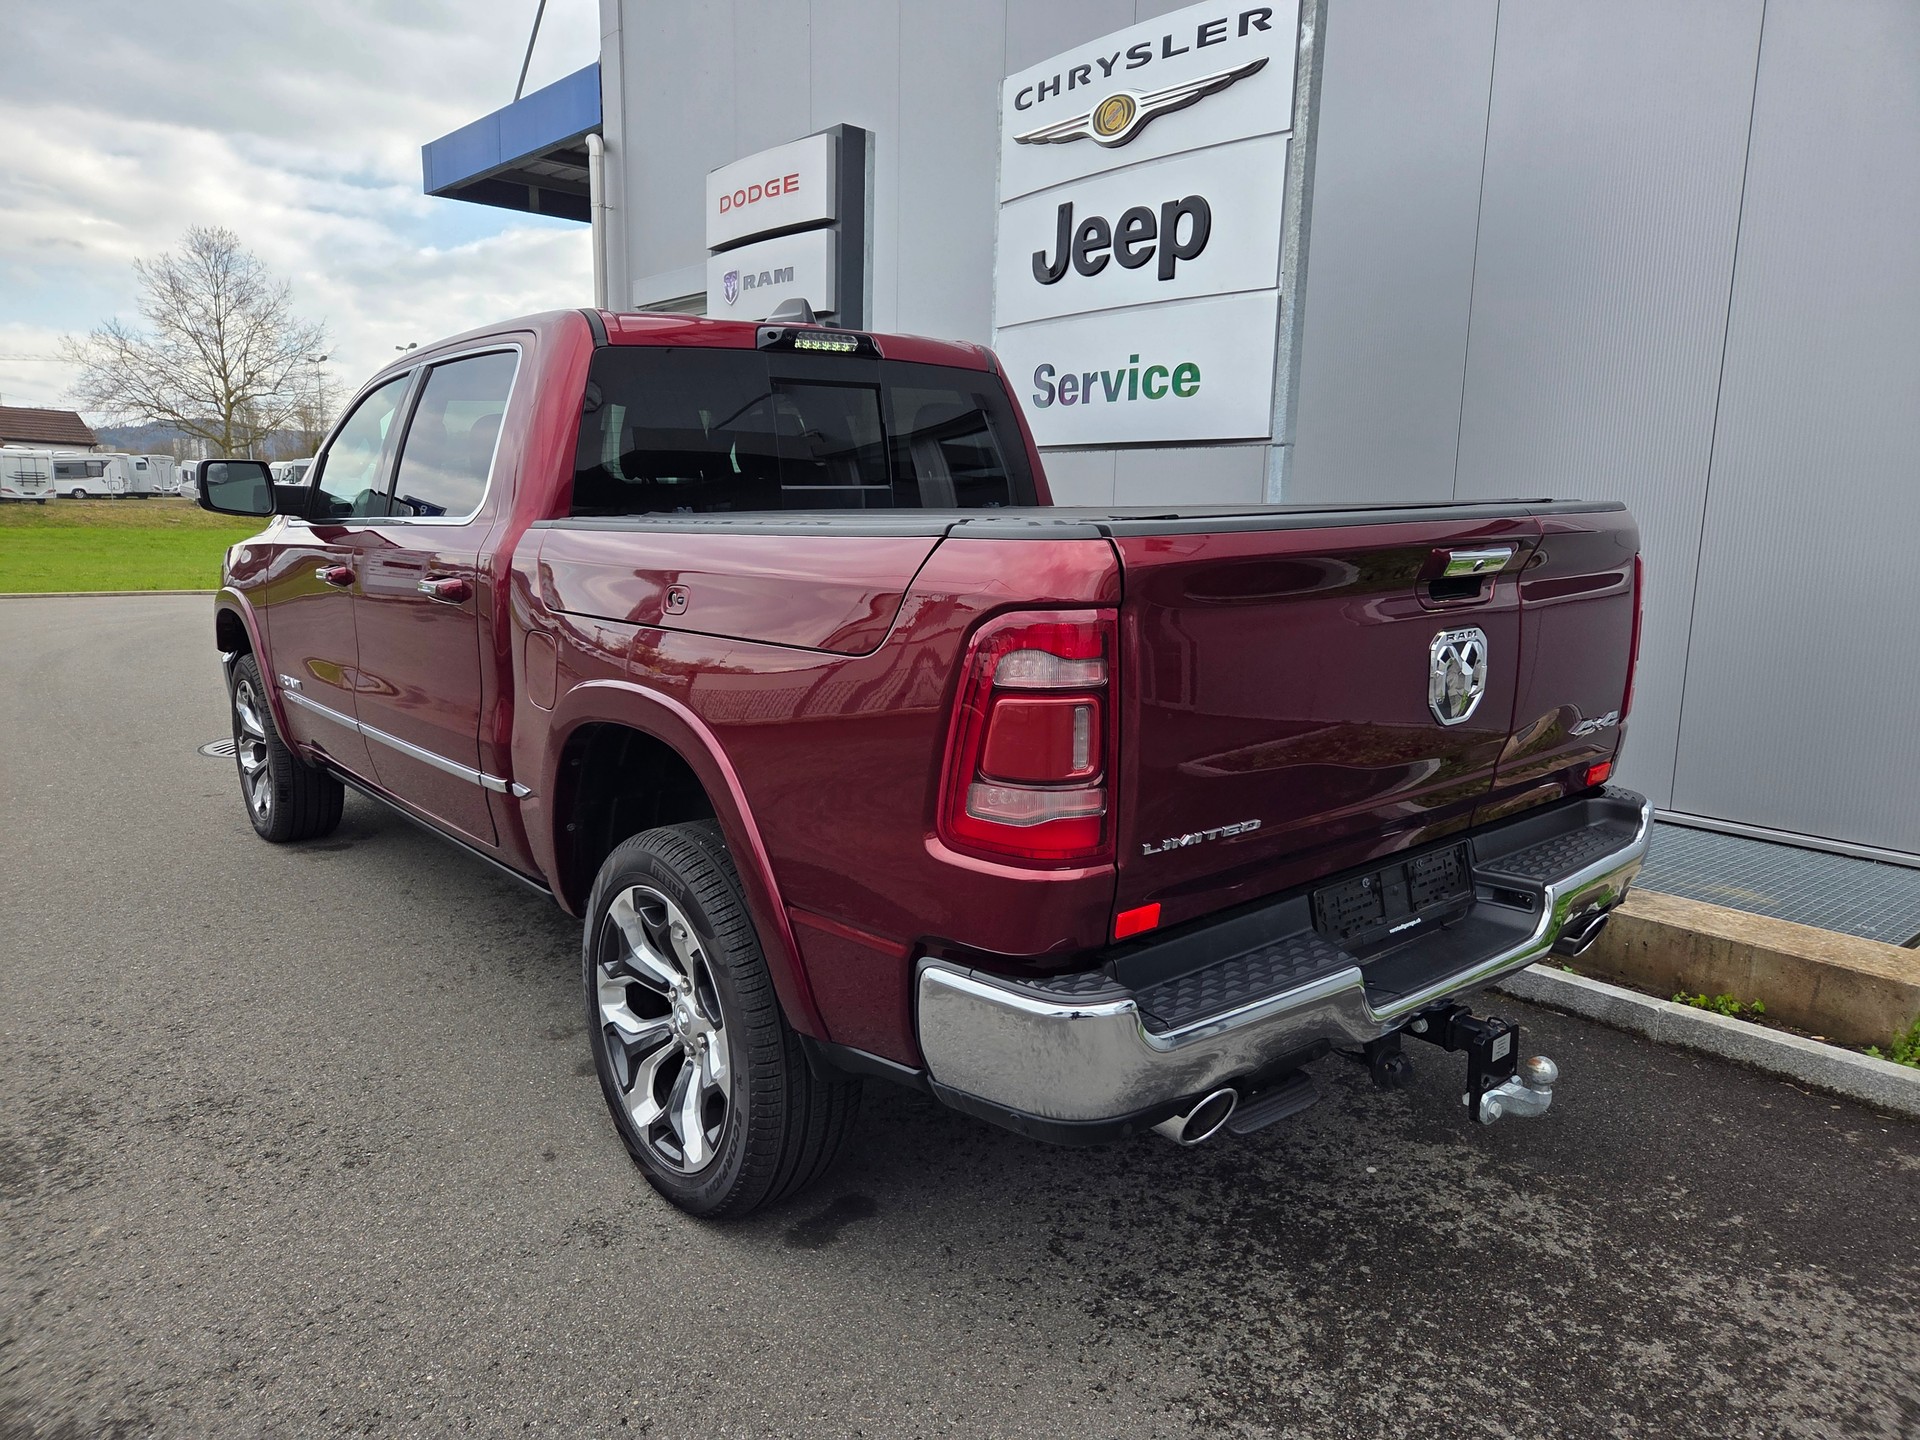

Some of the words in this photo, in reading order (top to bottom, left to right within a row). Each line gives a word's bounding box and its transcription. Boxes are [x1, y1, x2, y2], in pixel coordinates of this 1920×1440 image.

[1013, 7, 1273, 111] CHRYSLER
[720, 173, 800, 214] DODGE
[1032, 194, 1212, 286] Jeep
[743, 266, 794, 291] RAM
[1032, 353, 1201, 410] Service
[1446, 630, 1478, 641] RAM
[1142, 819, 1262, 855] LIMITED
[704, 1106, 742, 1198] SCORPION
